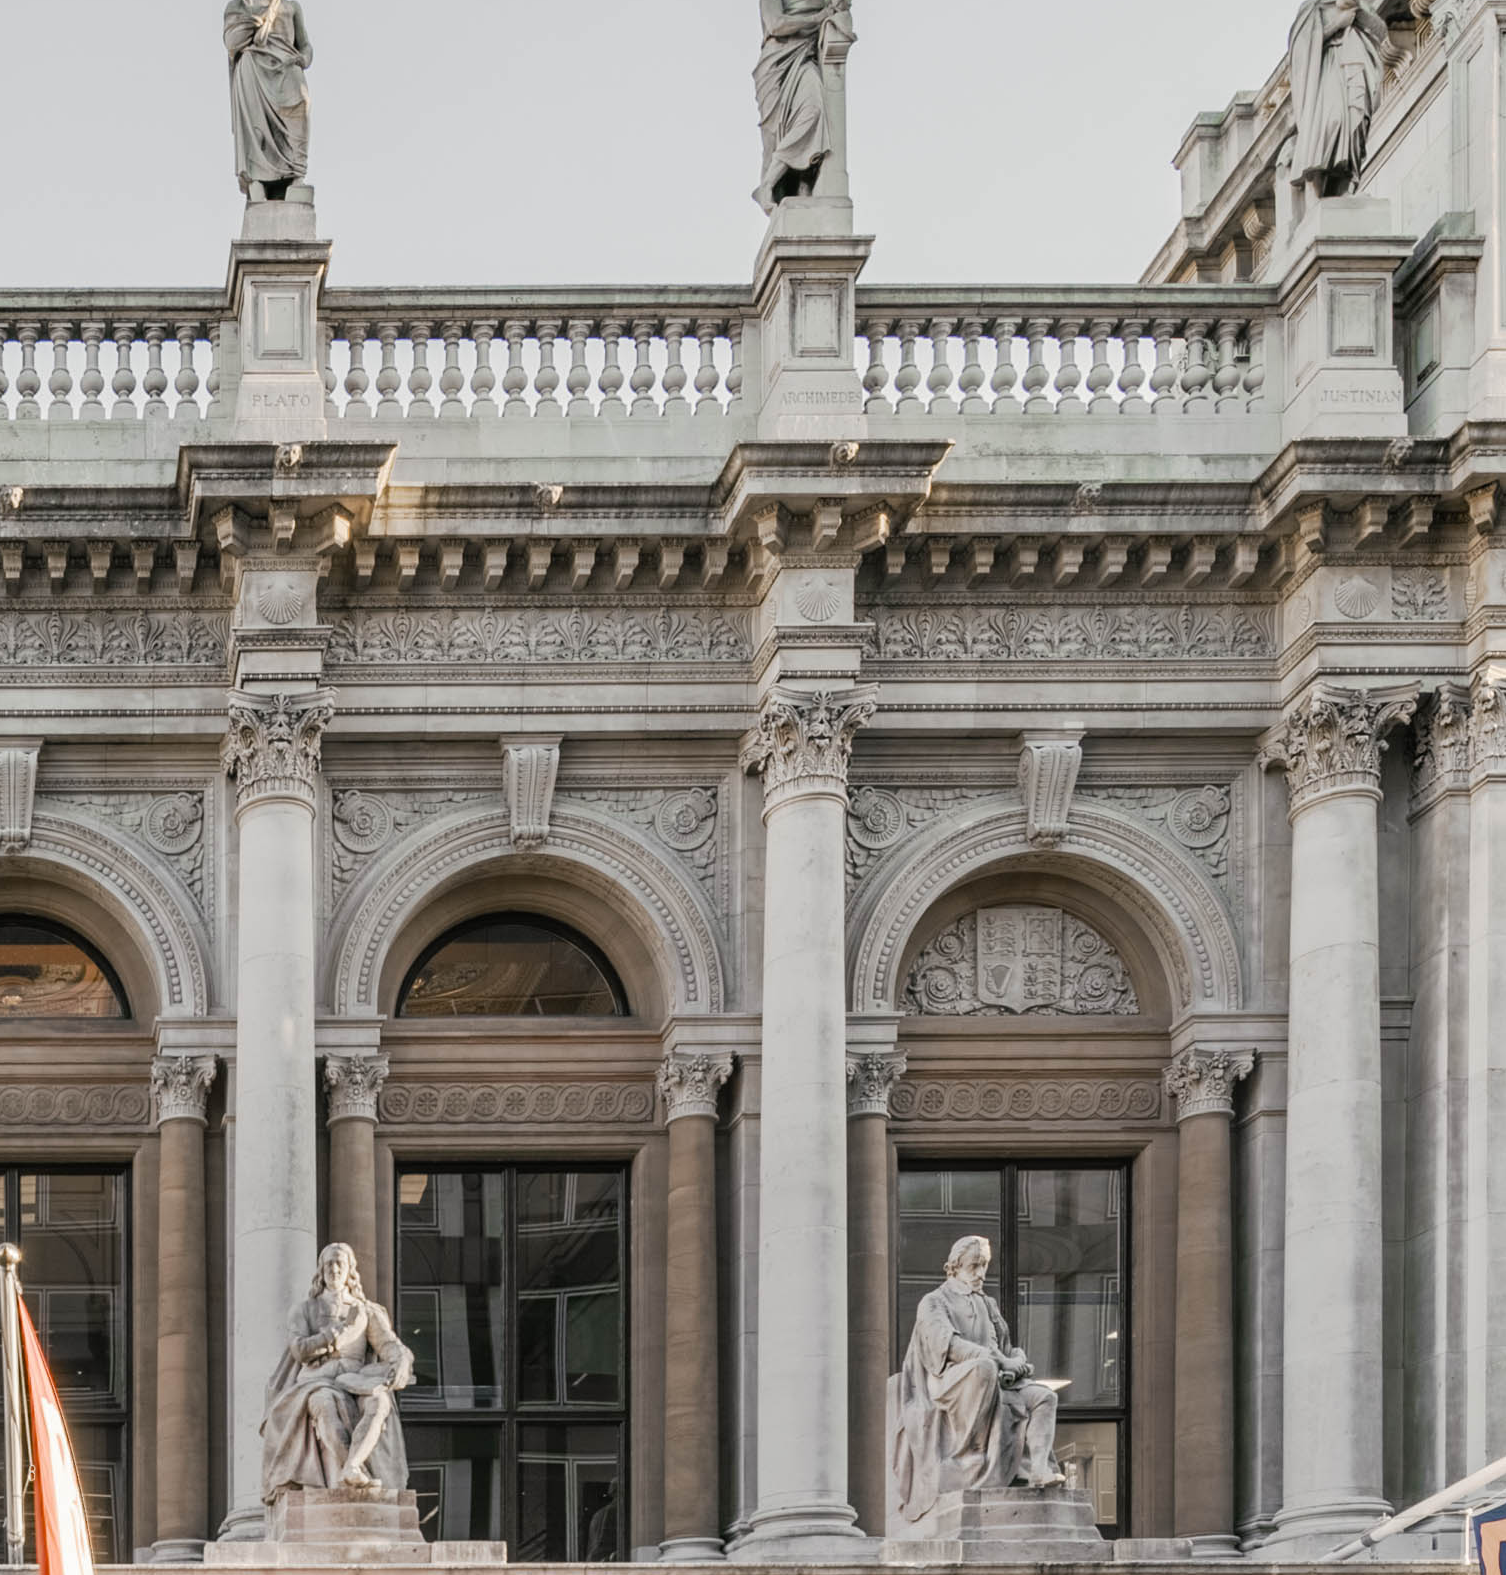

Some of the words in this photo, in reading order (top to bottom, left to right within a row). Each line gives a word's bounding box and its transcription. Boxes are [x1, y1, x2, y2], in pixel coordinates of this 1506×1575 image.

[251, 393, 310, 408] PLATO
[780, 391, 862, 405] ARCHIMEDES
[1320, 390, 1401, 402] JUSTINIAN
